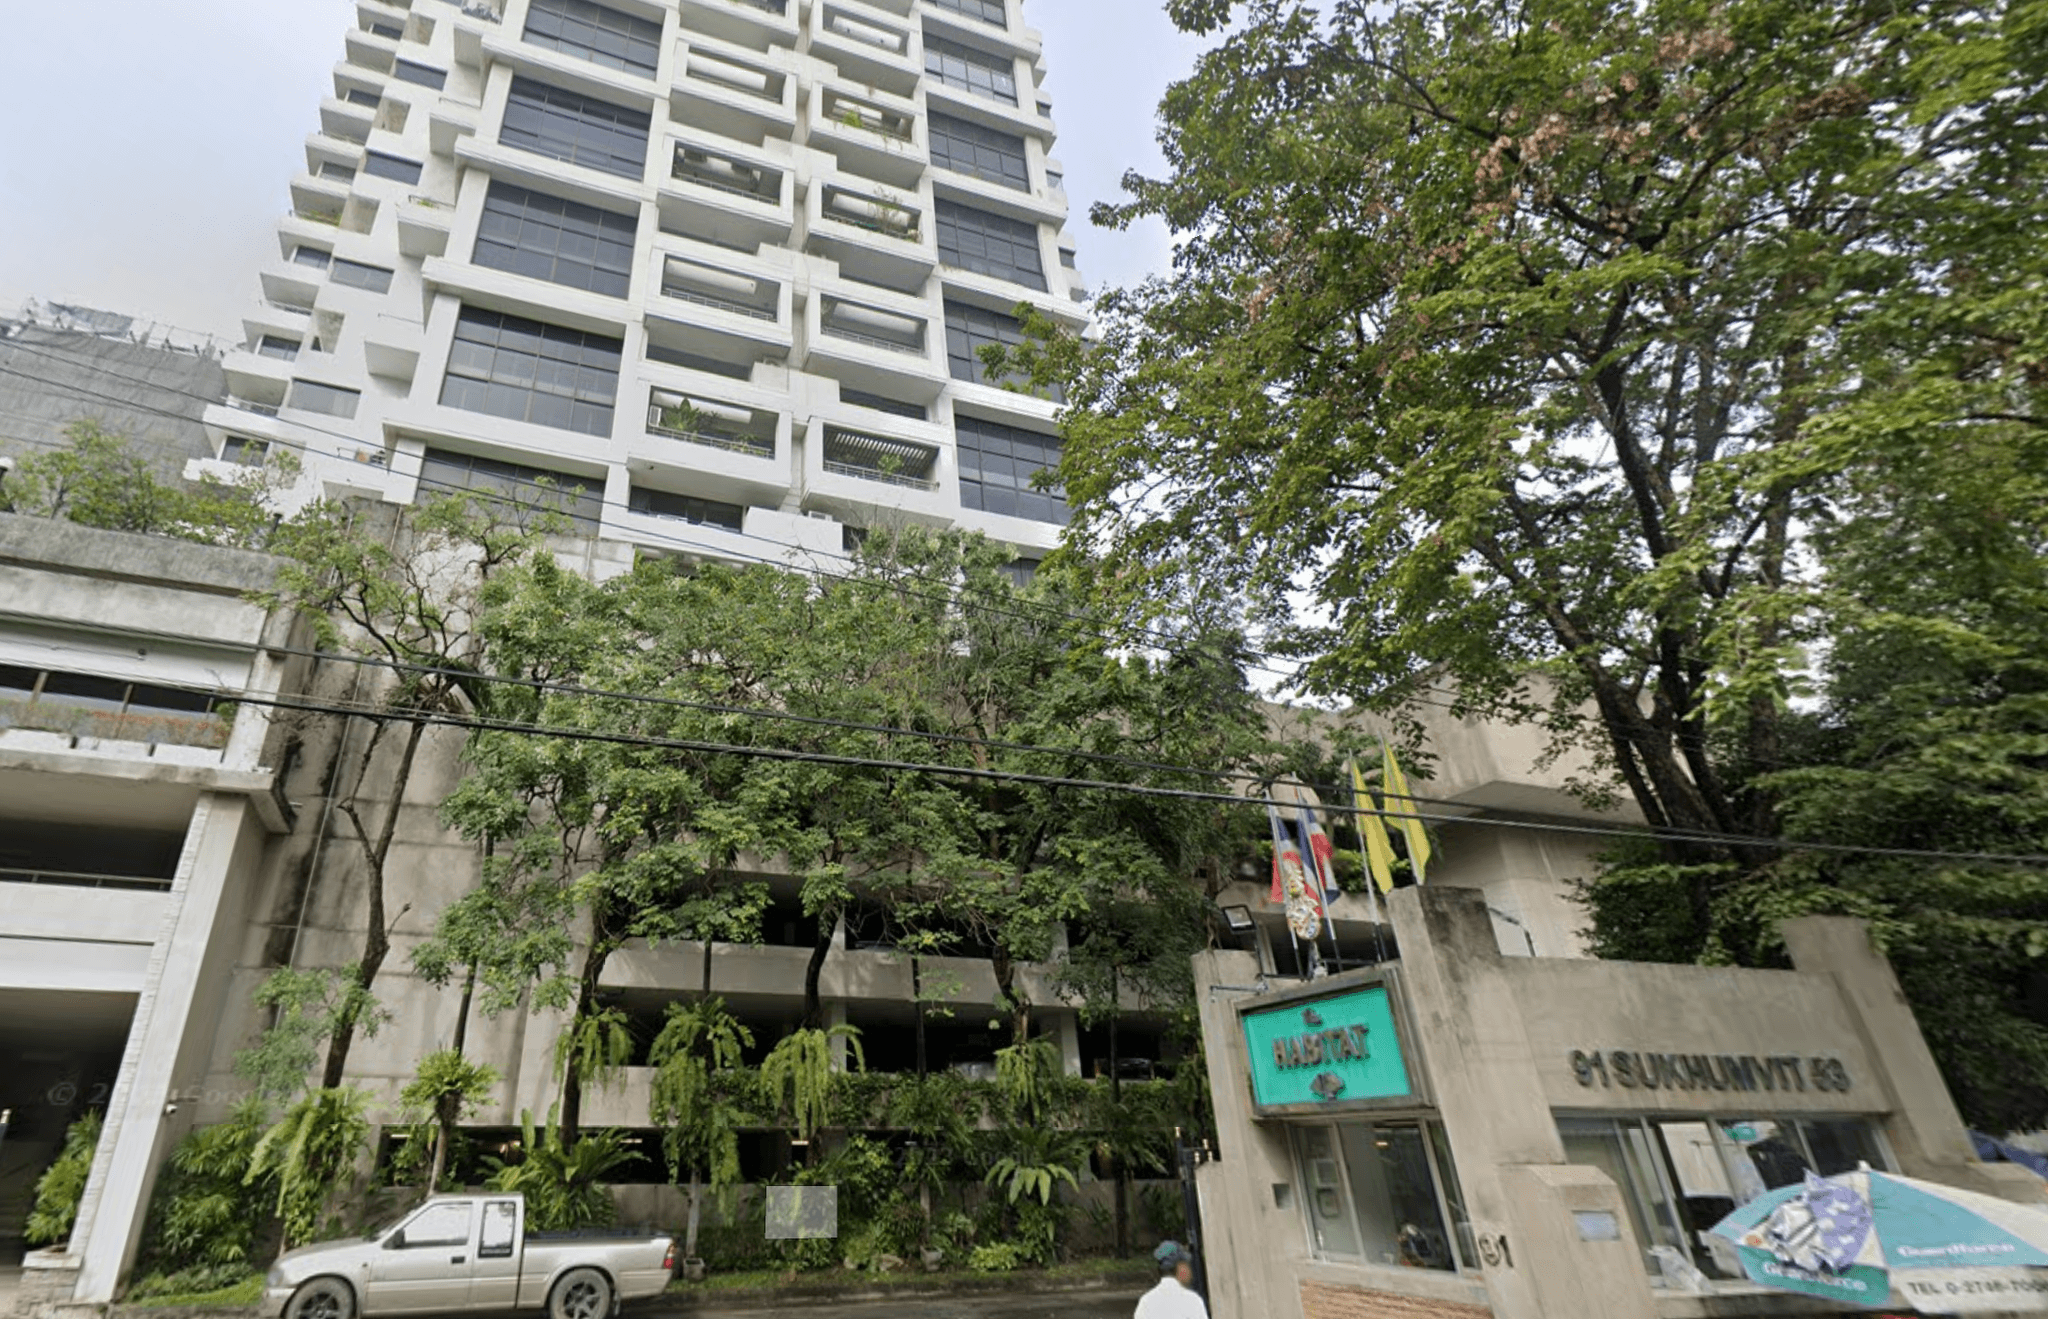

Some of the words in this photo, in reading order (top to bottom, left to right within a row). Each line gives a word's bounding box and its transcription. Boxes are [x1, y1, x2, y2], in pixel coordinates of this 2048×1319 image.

[1272, 1022, 1371, 1070] HABITAT
[1569, 1049, 1610, 1088] 91
[1610, 1051, 1804, 1092] SUKHUMVIT
[1810, 1056, 1851, 1094] 53
[1478, 1232, 1514, 1268] 91
